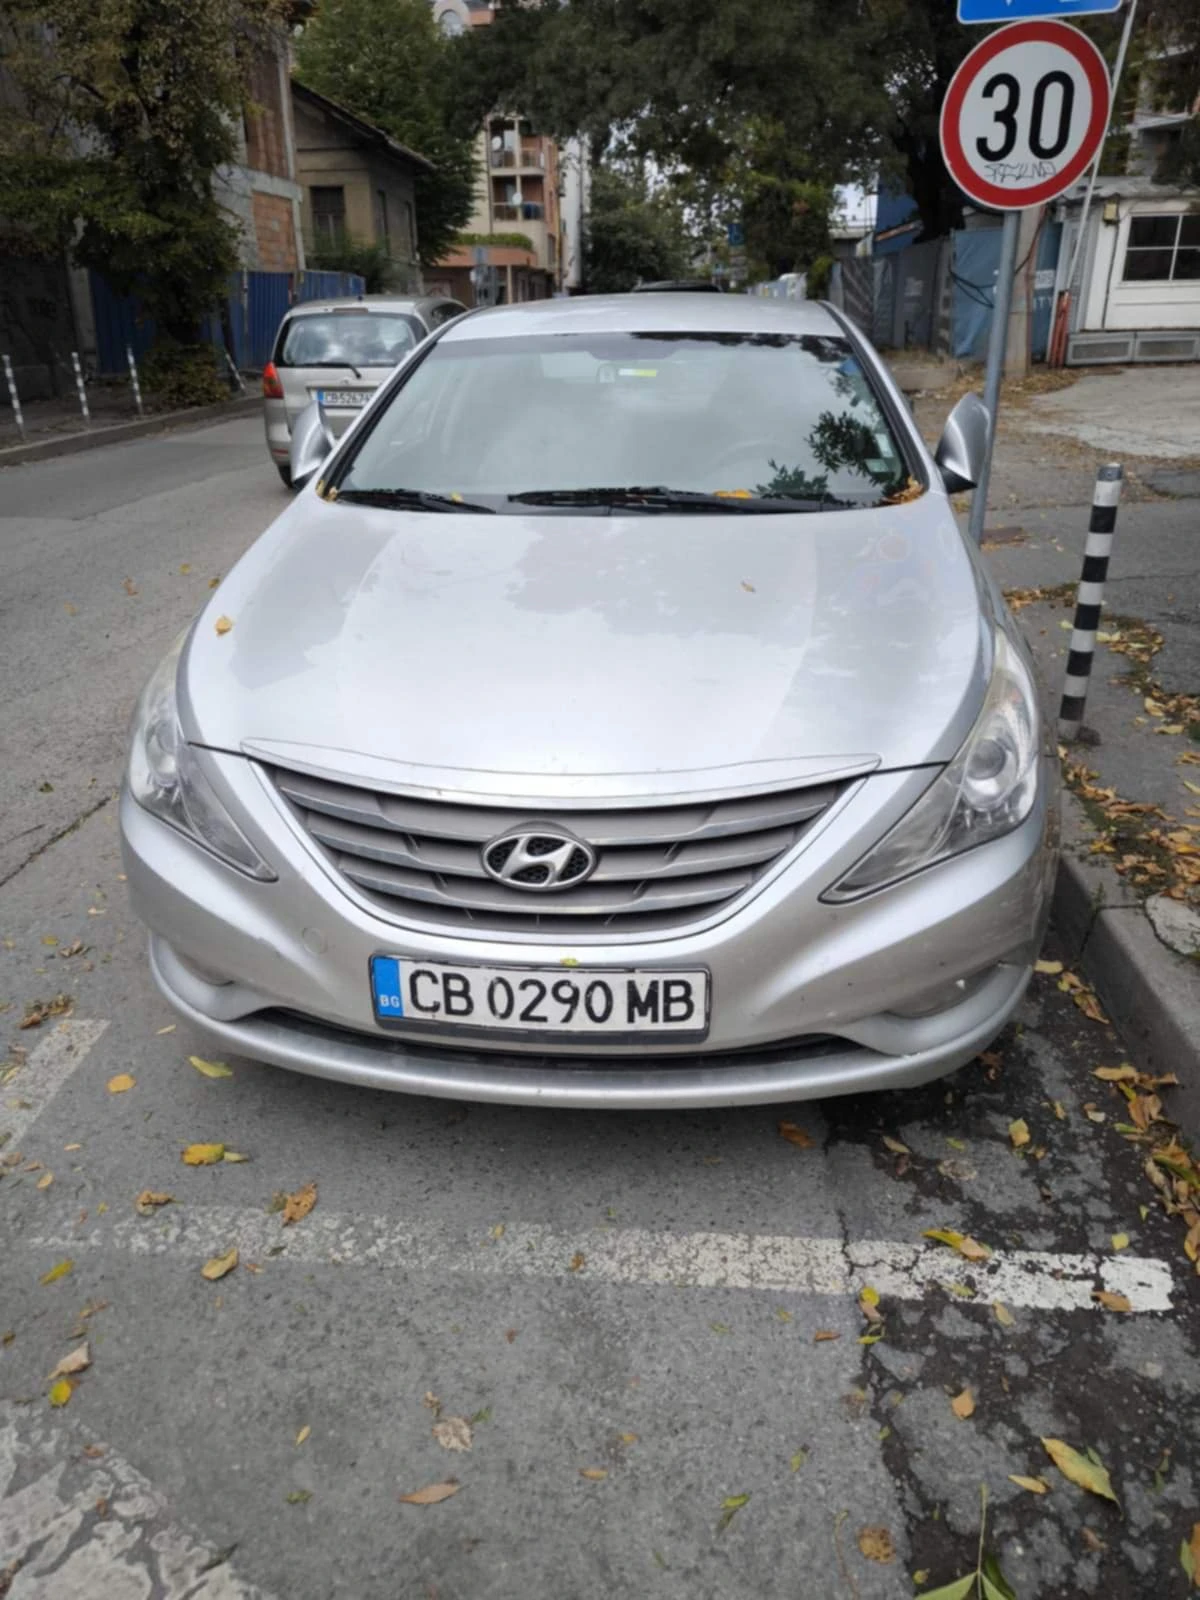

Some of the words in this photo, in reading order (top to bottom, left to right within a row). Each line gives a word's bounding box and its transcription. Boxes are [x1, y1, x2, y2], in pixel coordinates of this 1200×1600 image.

[976, 70, 1075, 162] 30
[380, 994, 400, 1008] BG
[409, 969, 474, 1017] CB
[487, 976, 614, 1023] 0290
[627, 979, 695, 1024] MB
